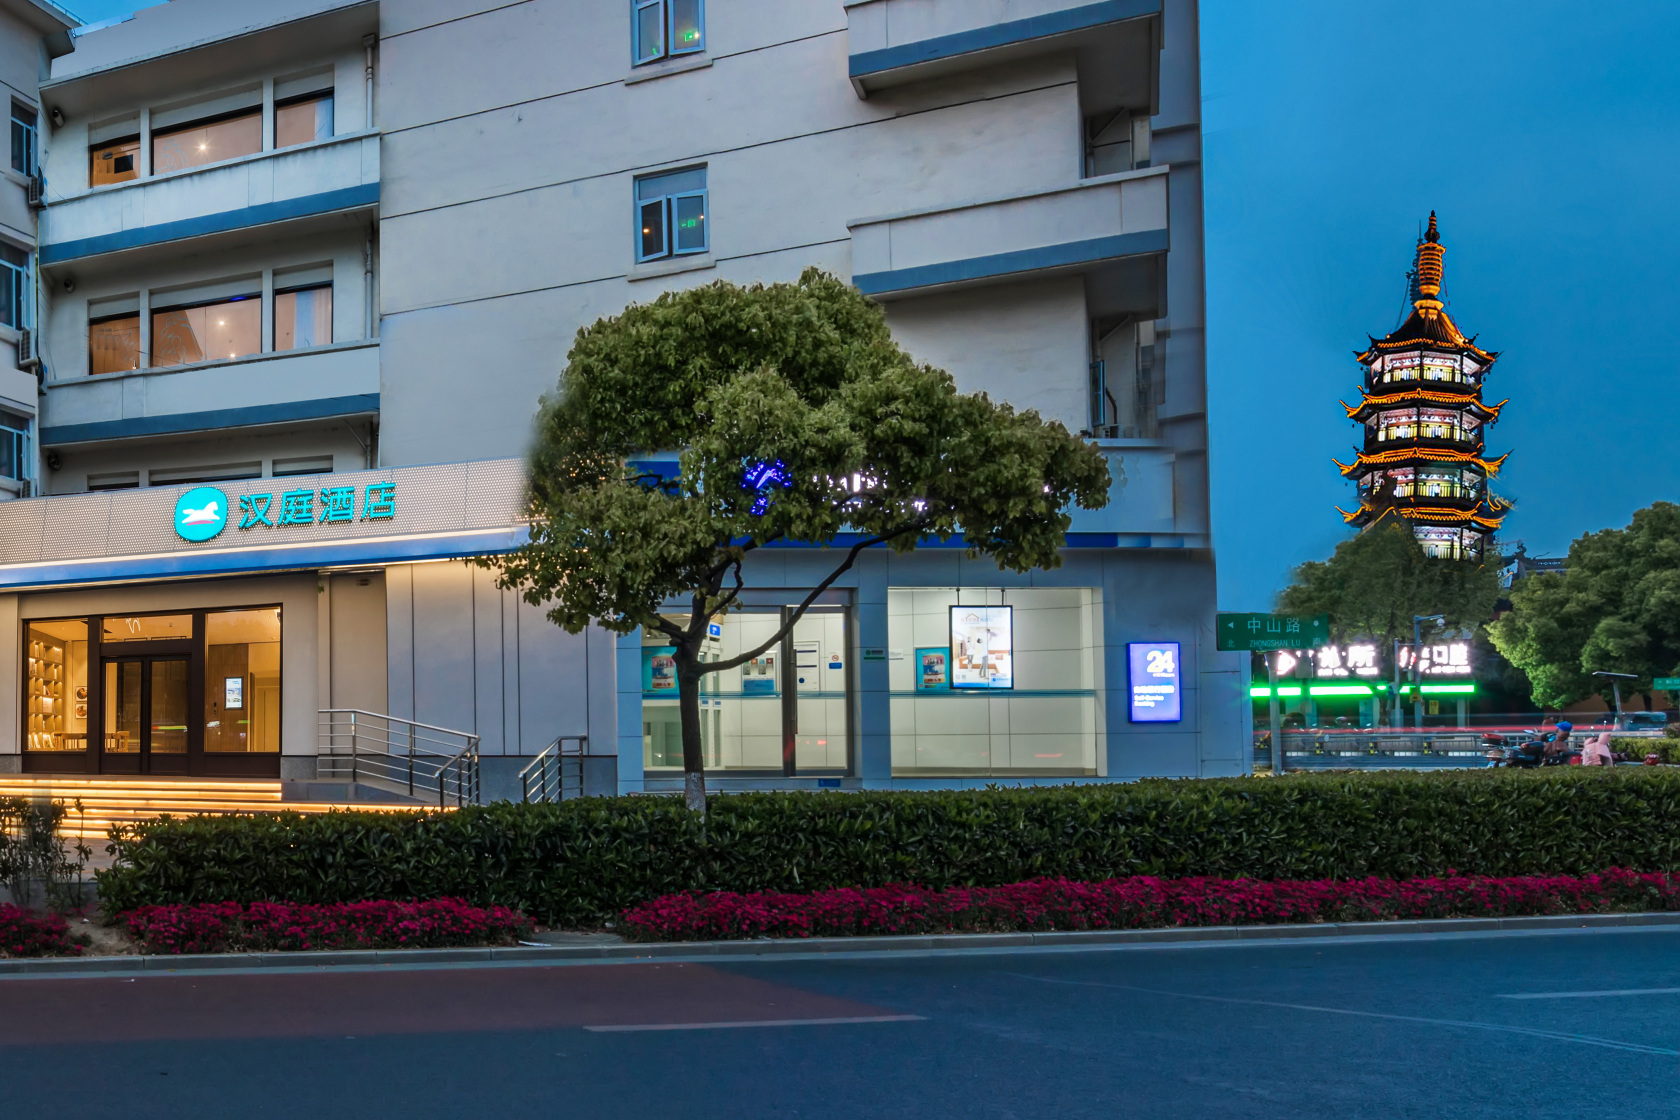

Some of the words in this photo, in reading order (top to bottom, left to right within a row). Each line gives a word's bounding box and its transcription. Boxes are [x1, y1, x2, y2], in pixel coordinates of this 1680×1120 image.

[238, 481, 396, 530] 汉庭酒店
[1247, 617, 1301, 634] 中山路
[1249, 639, 1288, 648] ZHONGSHAN
[1291, 639, 1301, 647] LU
[1146, 650, 1175, 673] 24
